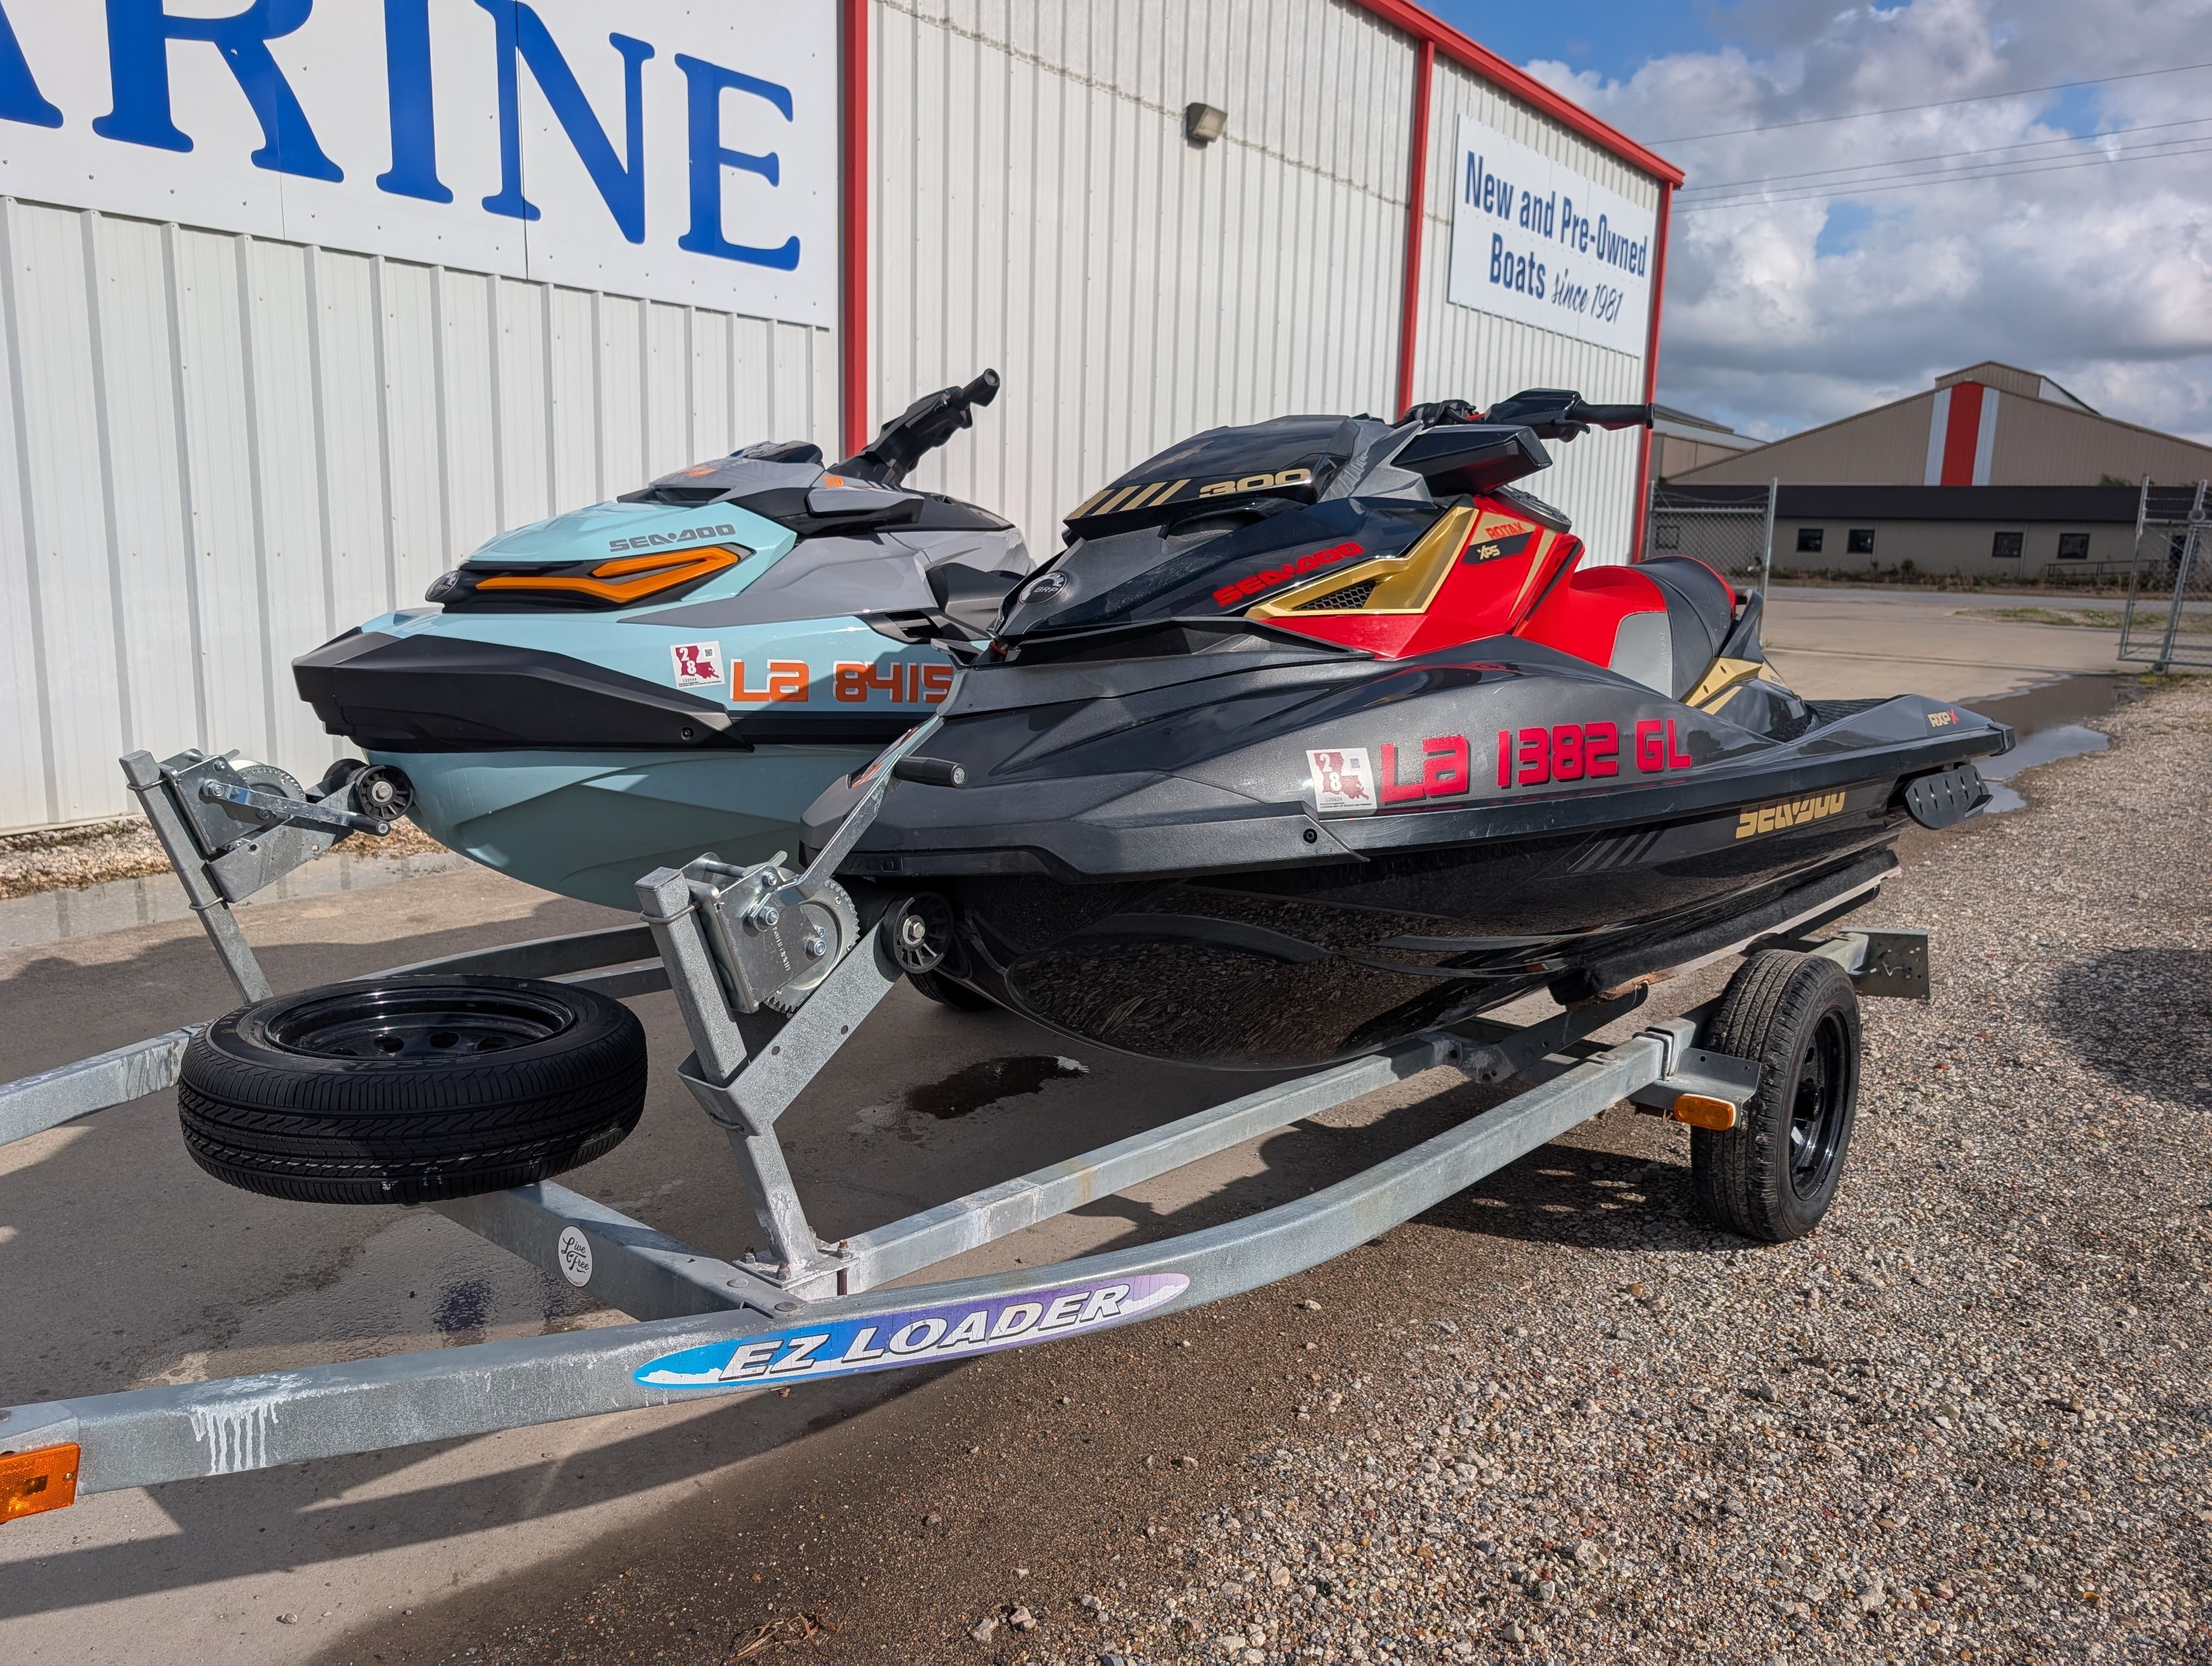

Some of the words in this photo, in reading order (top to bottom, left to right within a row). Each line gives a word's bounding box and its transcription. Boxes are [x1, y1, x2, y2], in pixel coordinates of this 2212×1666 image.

[0, 0, 800, 272] RINE
[1464, 150, 1515, 221] New
[1519, 190, 1556, 239] and
[1559, 195, 1648, 278] Pre-Owned
[1489, 232, 1546, 300] Boats
[1551, 268, 1591, 313] since
[1590, 282, 1624, 325] 1981
[1199, 468, 1312, 499] 300
[1476, 544, 1501, 560] XPS
[1484, 521, 1527, 540] ROTAX
[833, 660, 954, 703] 8415
[1497, 721, 1620, 788] 1382
[1636, 718, 1692, 774] GL
[561, 1236, 587, 1254] Live
[566, 1250, 590, 1271] Free
[719, 1333, 831, 1381] EZ
[840, 1283, 1131, 1364] LOADER
